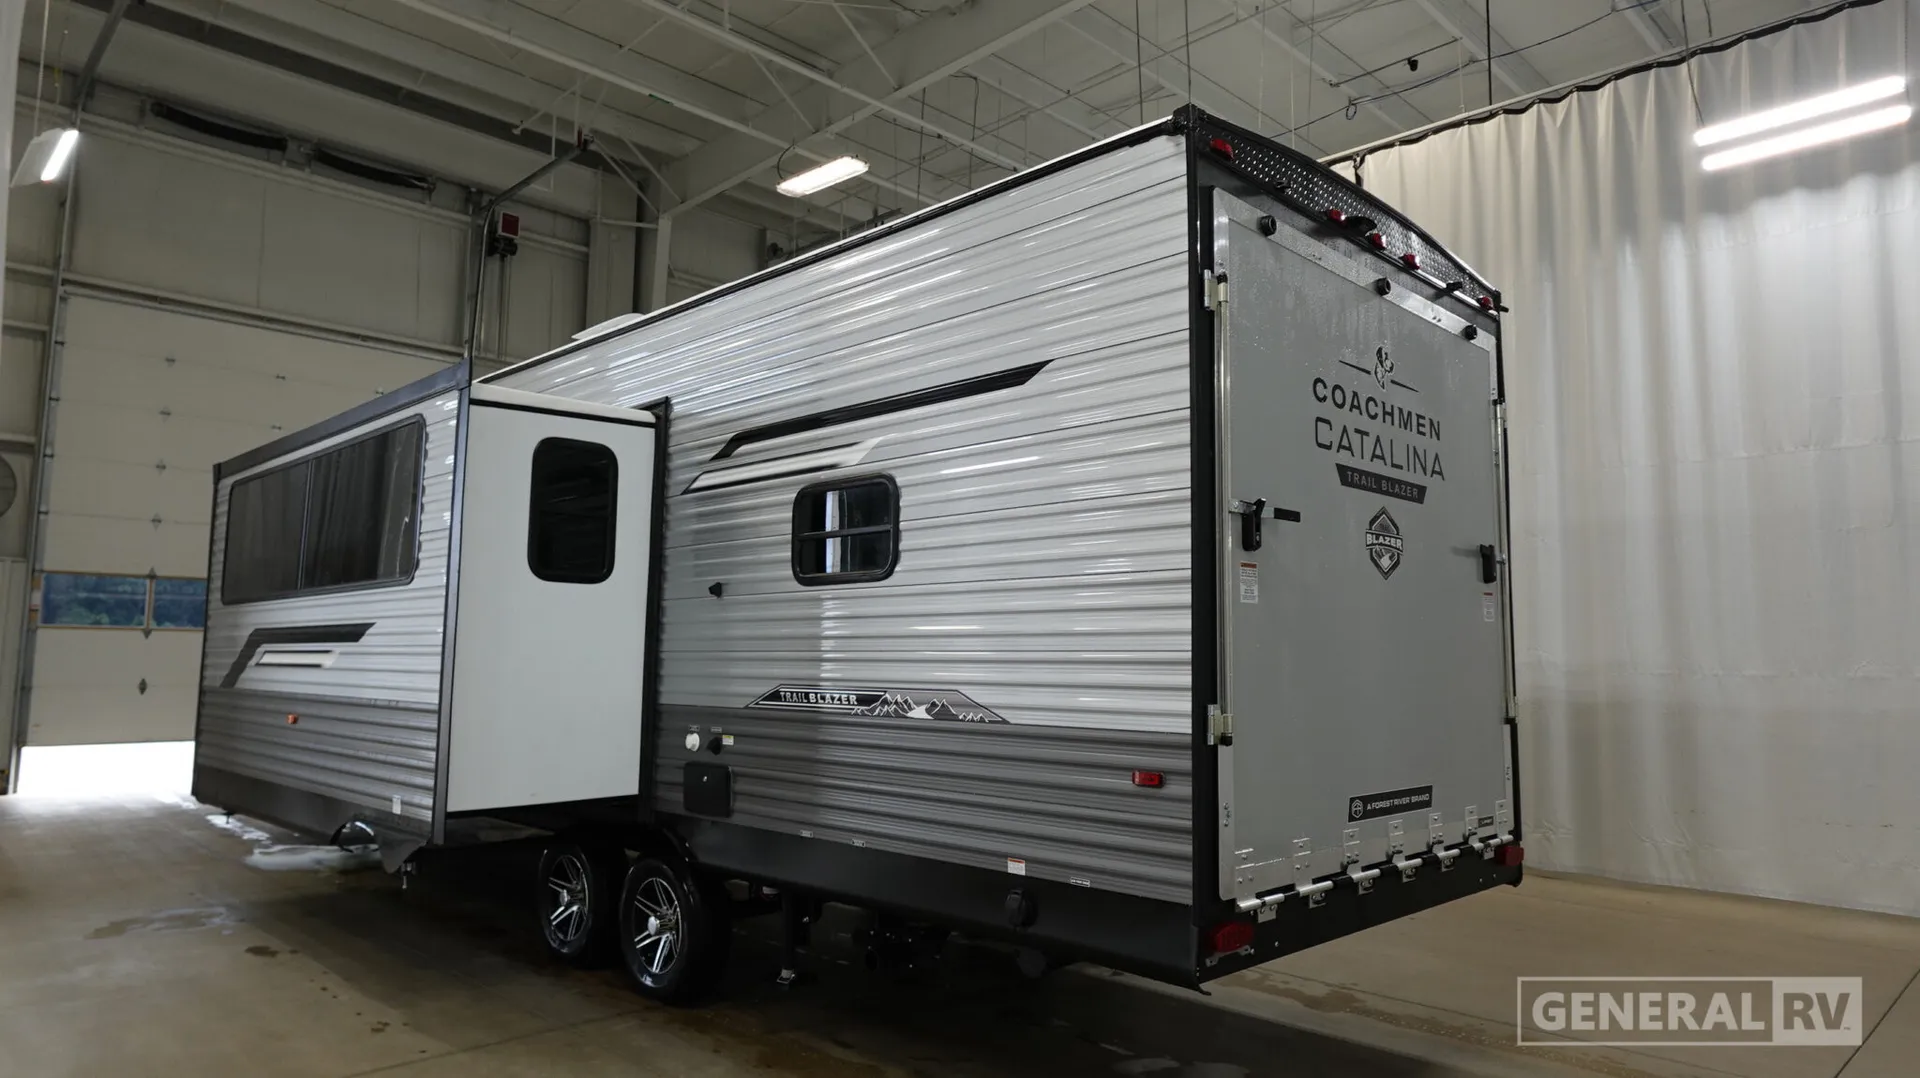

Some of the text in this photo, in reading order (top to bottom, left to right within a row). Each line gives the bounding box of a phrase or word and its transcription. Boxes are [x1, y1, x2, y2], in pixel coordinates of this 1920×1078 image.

[1312, 377, 1441, 441] COACHMEN
[1314, 416, 1445, 481] CATALINA
[1346, 471, 1419, 499] TRAIL BLAZER
[1366, 532, 1403, 550] BLAZER
[780, 692, 858, 706] TRAIL BLAZER
[1372, 799, 1393, 809] FOREST
[1411, 793, 1430, 803] BRAND
